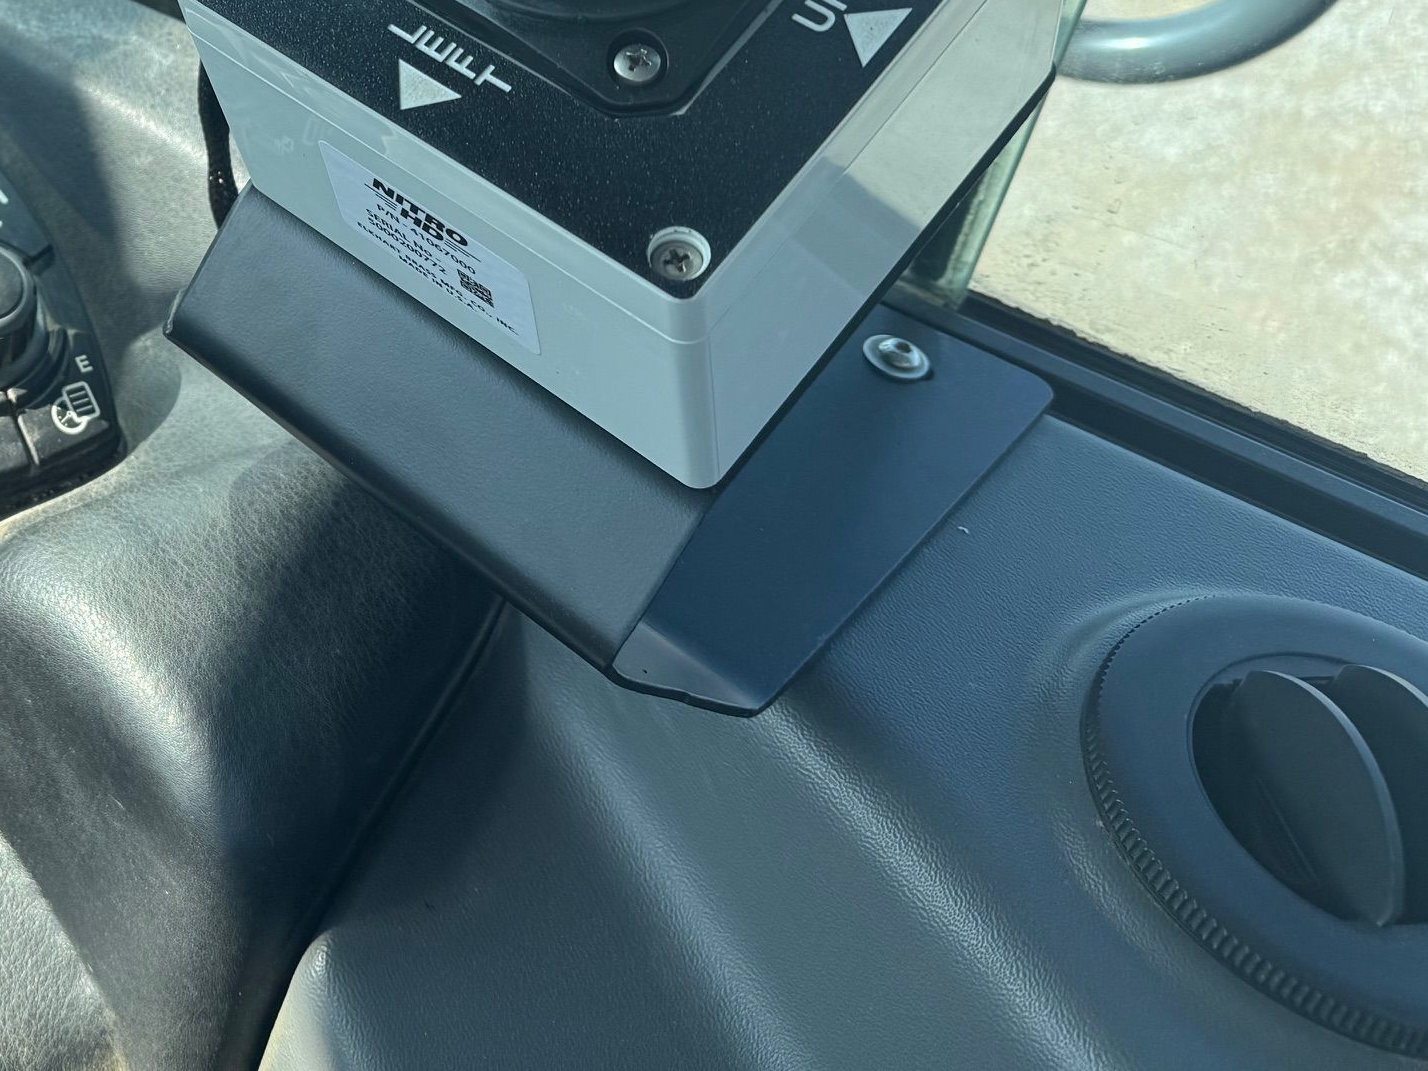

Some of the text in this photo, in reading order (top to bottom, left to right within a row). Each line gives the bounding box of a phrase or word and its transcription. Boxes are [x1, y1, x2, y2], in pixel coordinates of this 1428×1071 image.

[387, 23, 512, 94] LEFT
[366, 209, 411, 243] SERIAL
[373, 178, 468, 246] NITRO
[400, 208, 444, 242] HD
[377, 204, 400, 224] P/N
[410, 228, 476, 275] 41067000
[75, 354, 94, 374] E
